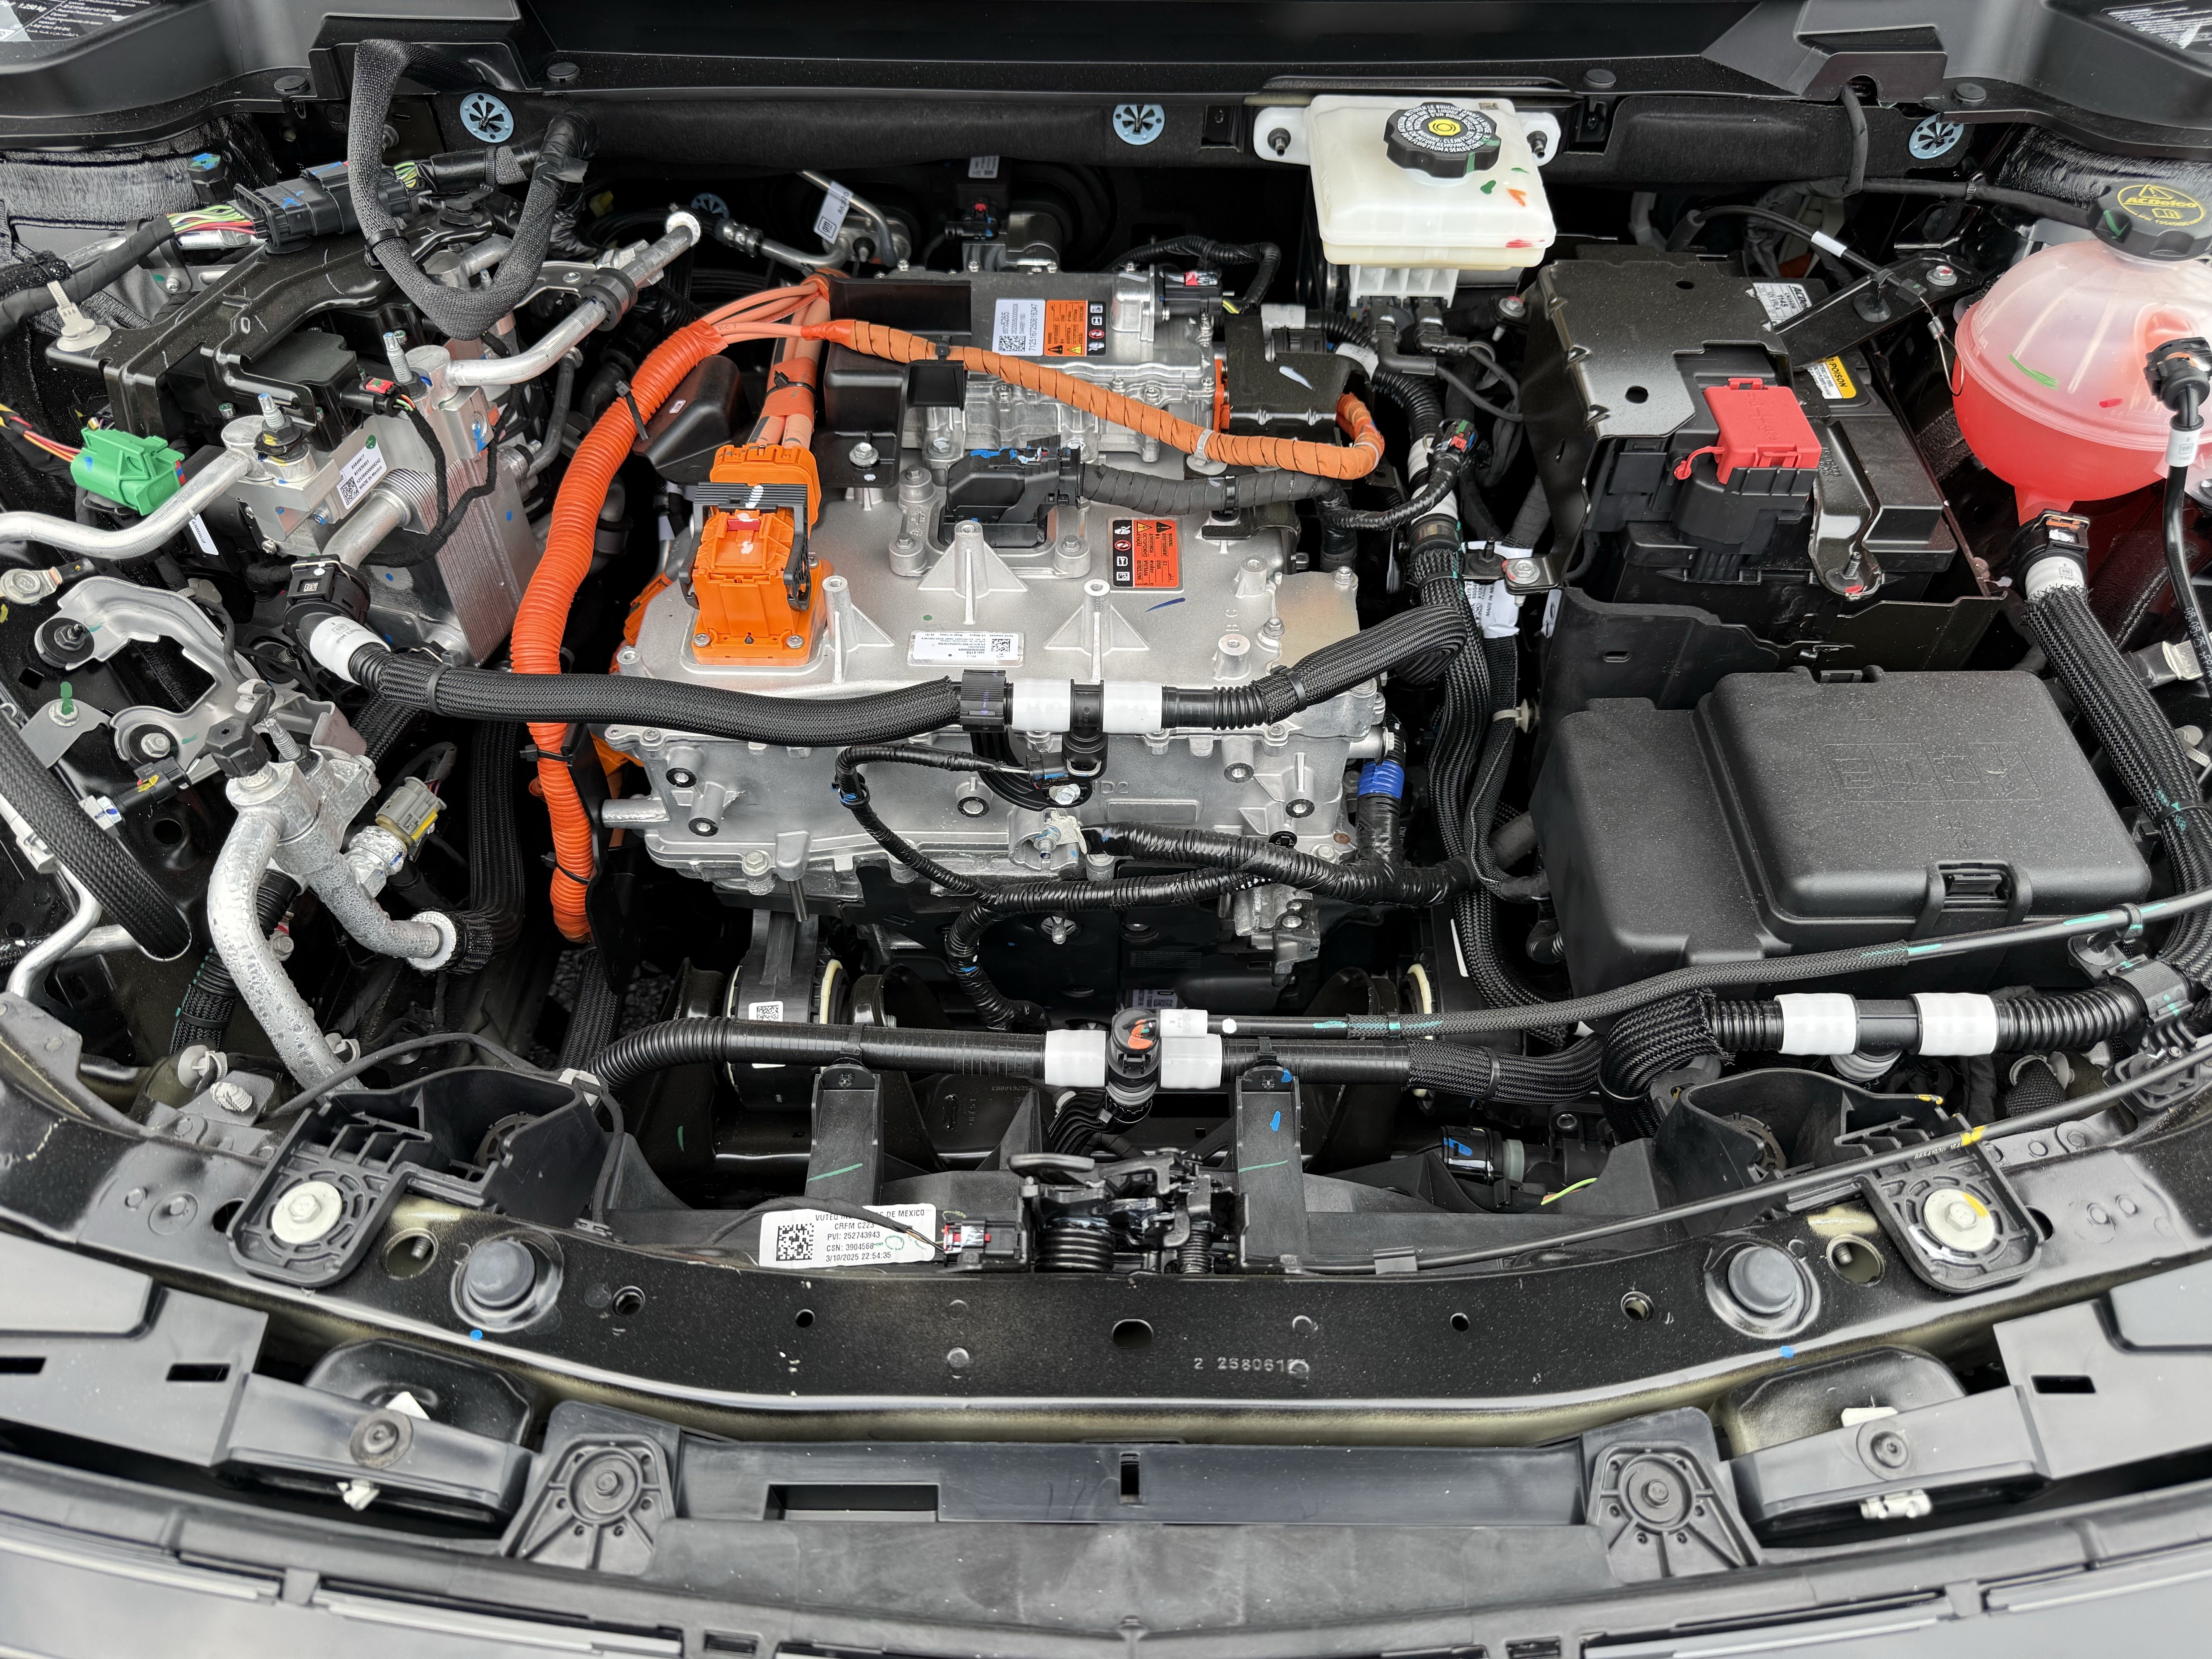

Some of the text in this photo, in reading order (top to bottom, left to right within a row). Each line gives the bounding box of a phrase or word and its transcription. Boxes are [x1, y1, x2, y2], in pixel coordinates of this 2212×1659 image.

[2125, 198, 2198, 208] ACDelco
[1792, 286, 1808, 310] ACDel
[898, 1209, 925, 1217] MEXICO
[844, 1231, 880, 1240] 252743943
[826, 1252, 891, 1262] 3/10/2025 22:54:35
[1194, 1357, 1306, 1373] 2 258061
